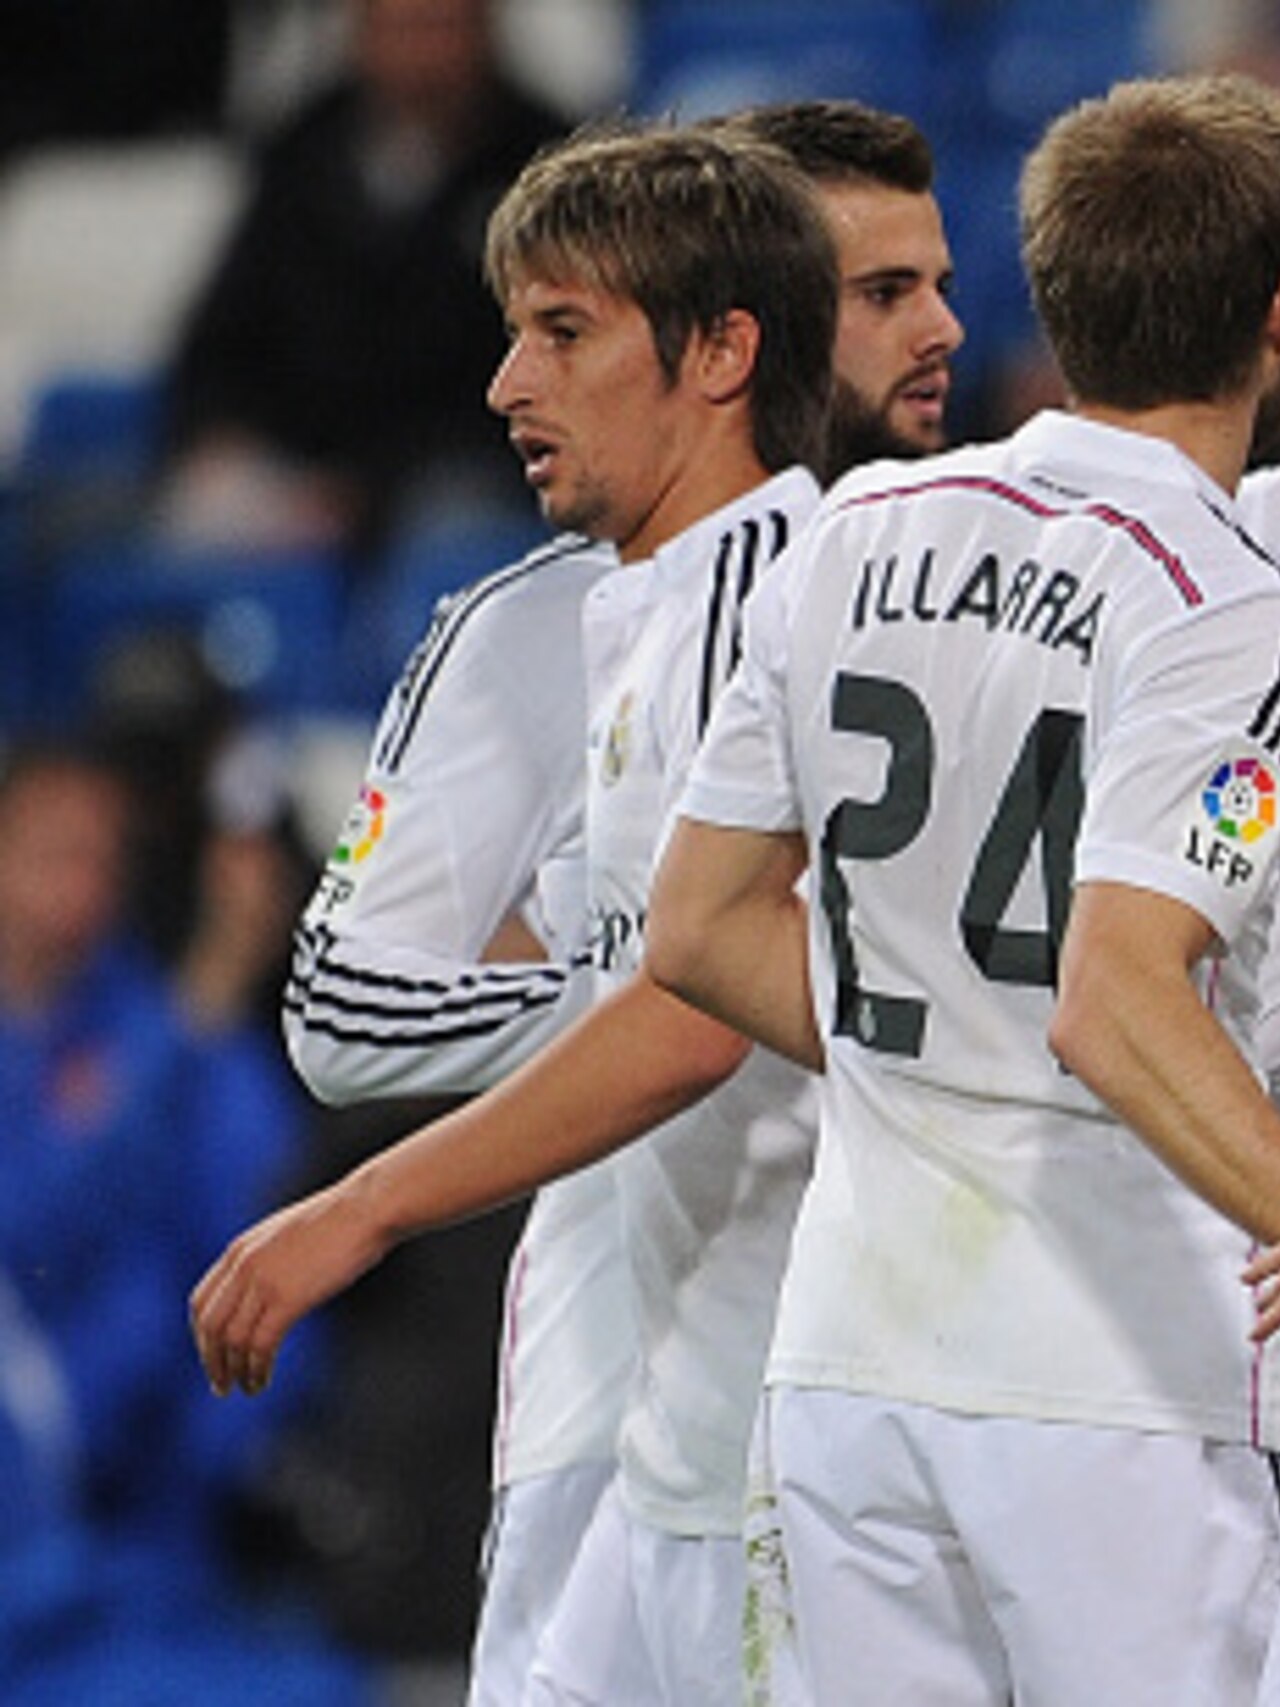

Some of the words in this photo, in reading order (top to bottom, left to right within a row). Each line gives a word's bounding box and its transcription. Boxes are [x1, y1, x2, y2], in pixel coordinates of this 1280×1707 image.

[853, 548, 1106, 666] ILLARRA
[820, 671, 1086, 1072] 24
[1184, 825, 1254, 887] LFP
